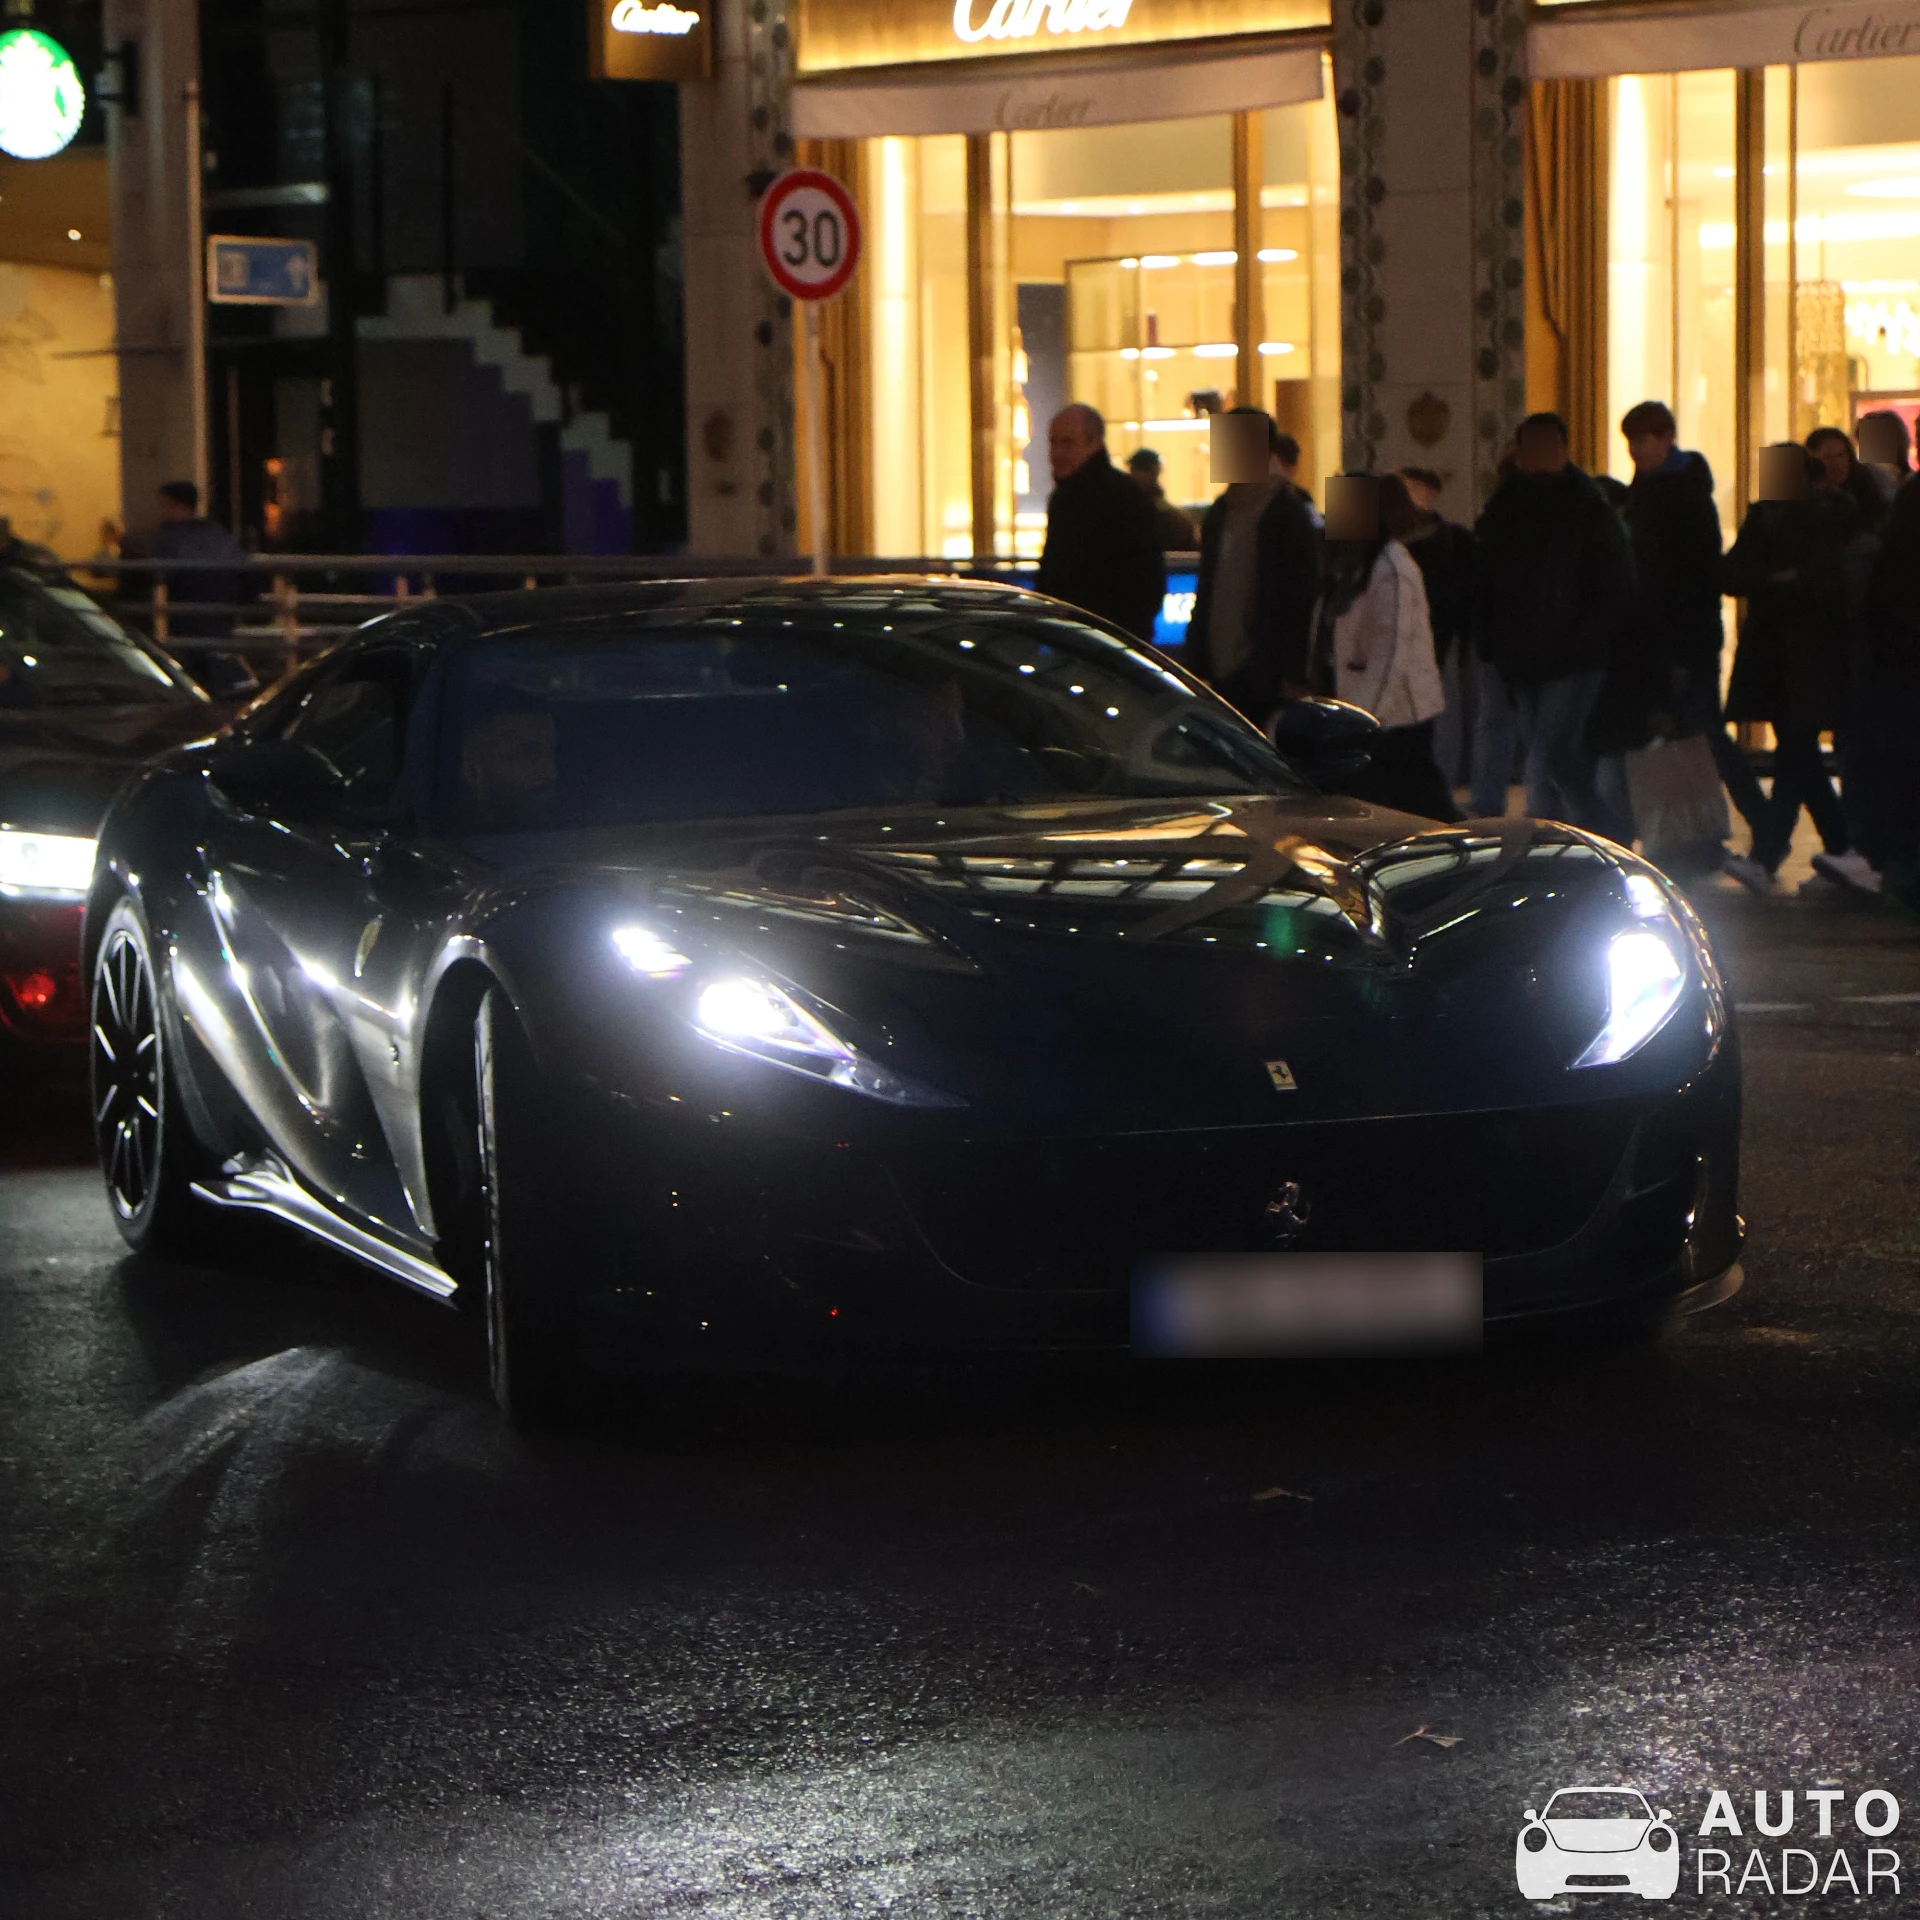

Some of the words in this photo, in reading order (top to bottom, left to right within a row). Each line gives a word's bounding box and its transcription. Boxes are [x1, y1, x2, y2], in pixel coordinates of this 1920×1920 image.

[611, 0, 700, 35] Cartier
[1793, 6, 1920, 58] Cartier
[995, 86, 1097, 128] Cartier
[784, 209, 840, 267] 30
